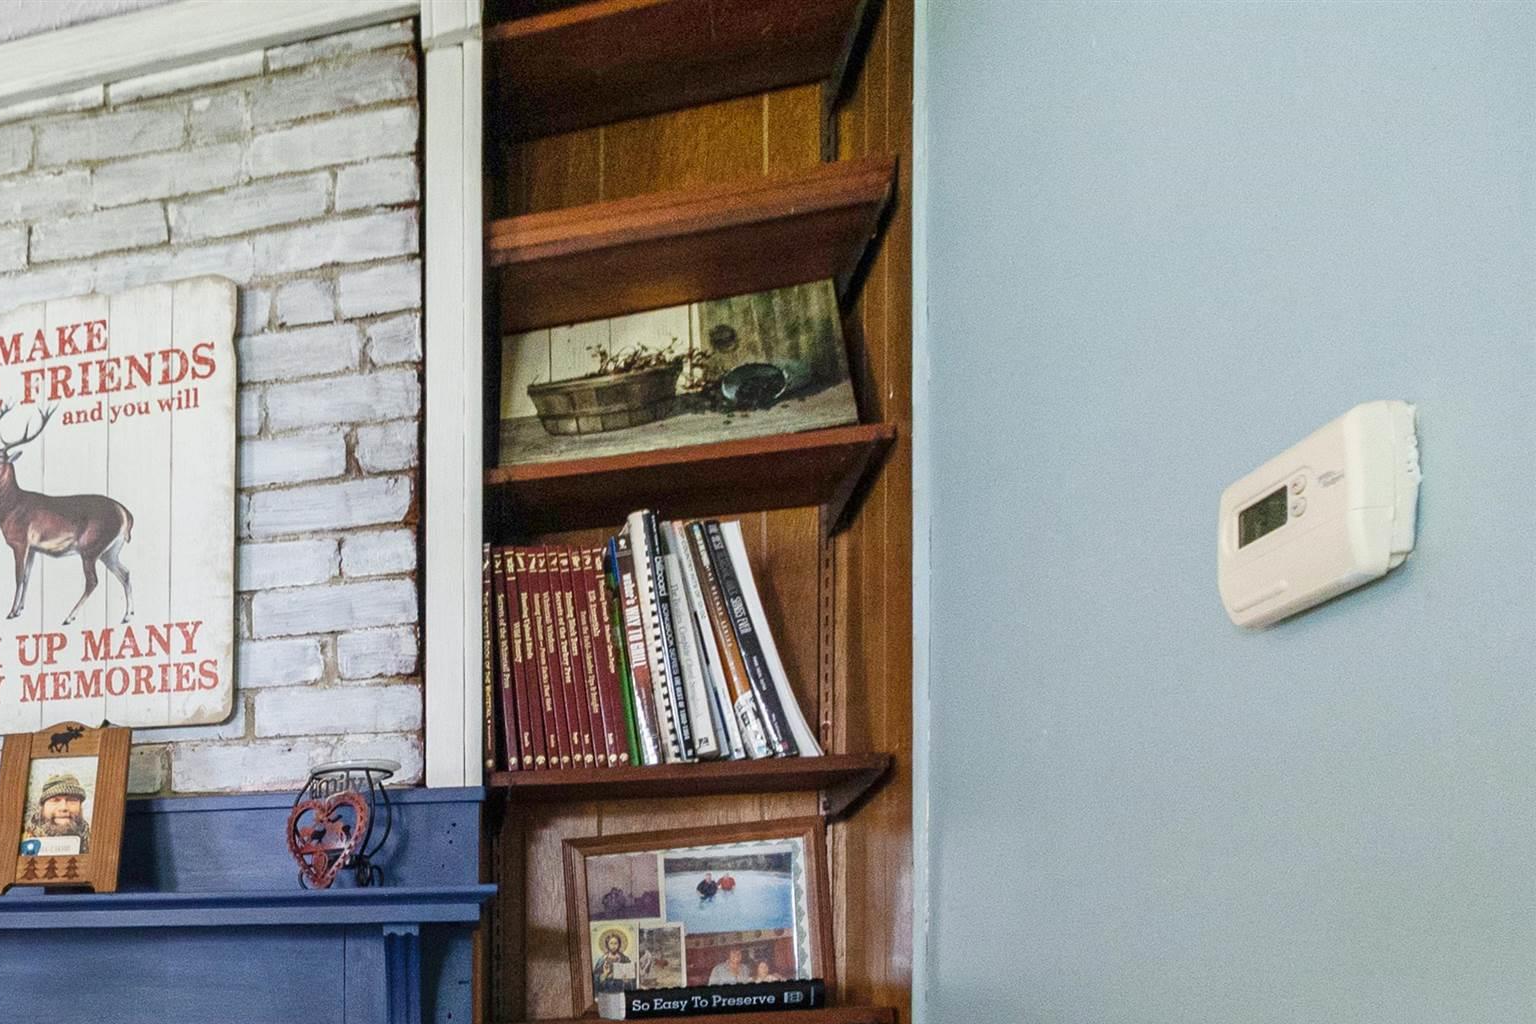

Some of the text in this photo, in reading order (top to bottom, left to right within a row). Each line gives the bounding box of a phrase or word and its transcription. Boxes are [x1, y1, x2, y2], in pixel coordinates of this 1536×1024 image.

[21, 342, 216, 405] FRIENDS
[61, 388, 199, 426] and you will
[653, 555, 668, 596] billboard
[625, 605, 639, 627] WAY
[728, 594, 747, 619] SONGS
[629, 626, 642, 642] TO
[735, 616, 752, 635] EVER
[17, 633, 65, 667] UP
[82, 621, 202, 662] MANY
[631, 640, 646, 667] GRILL
[20, 659, 219, 703] MEMORIES
[632, 1000, 650, 1012] So
[654, 998, 687, 1011] Easy
[692, 996, 708, 1008] To
[712, 994, 776, 1007] Preserve
